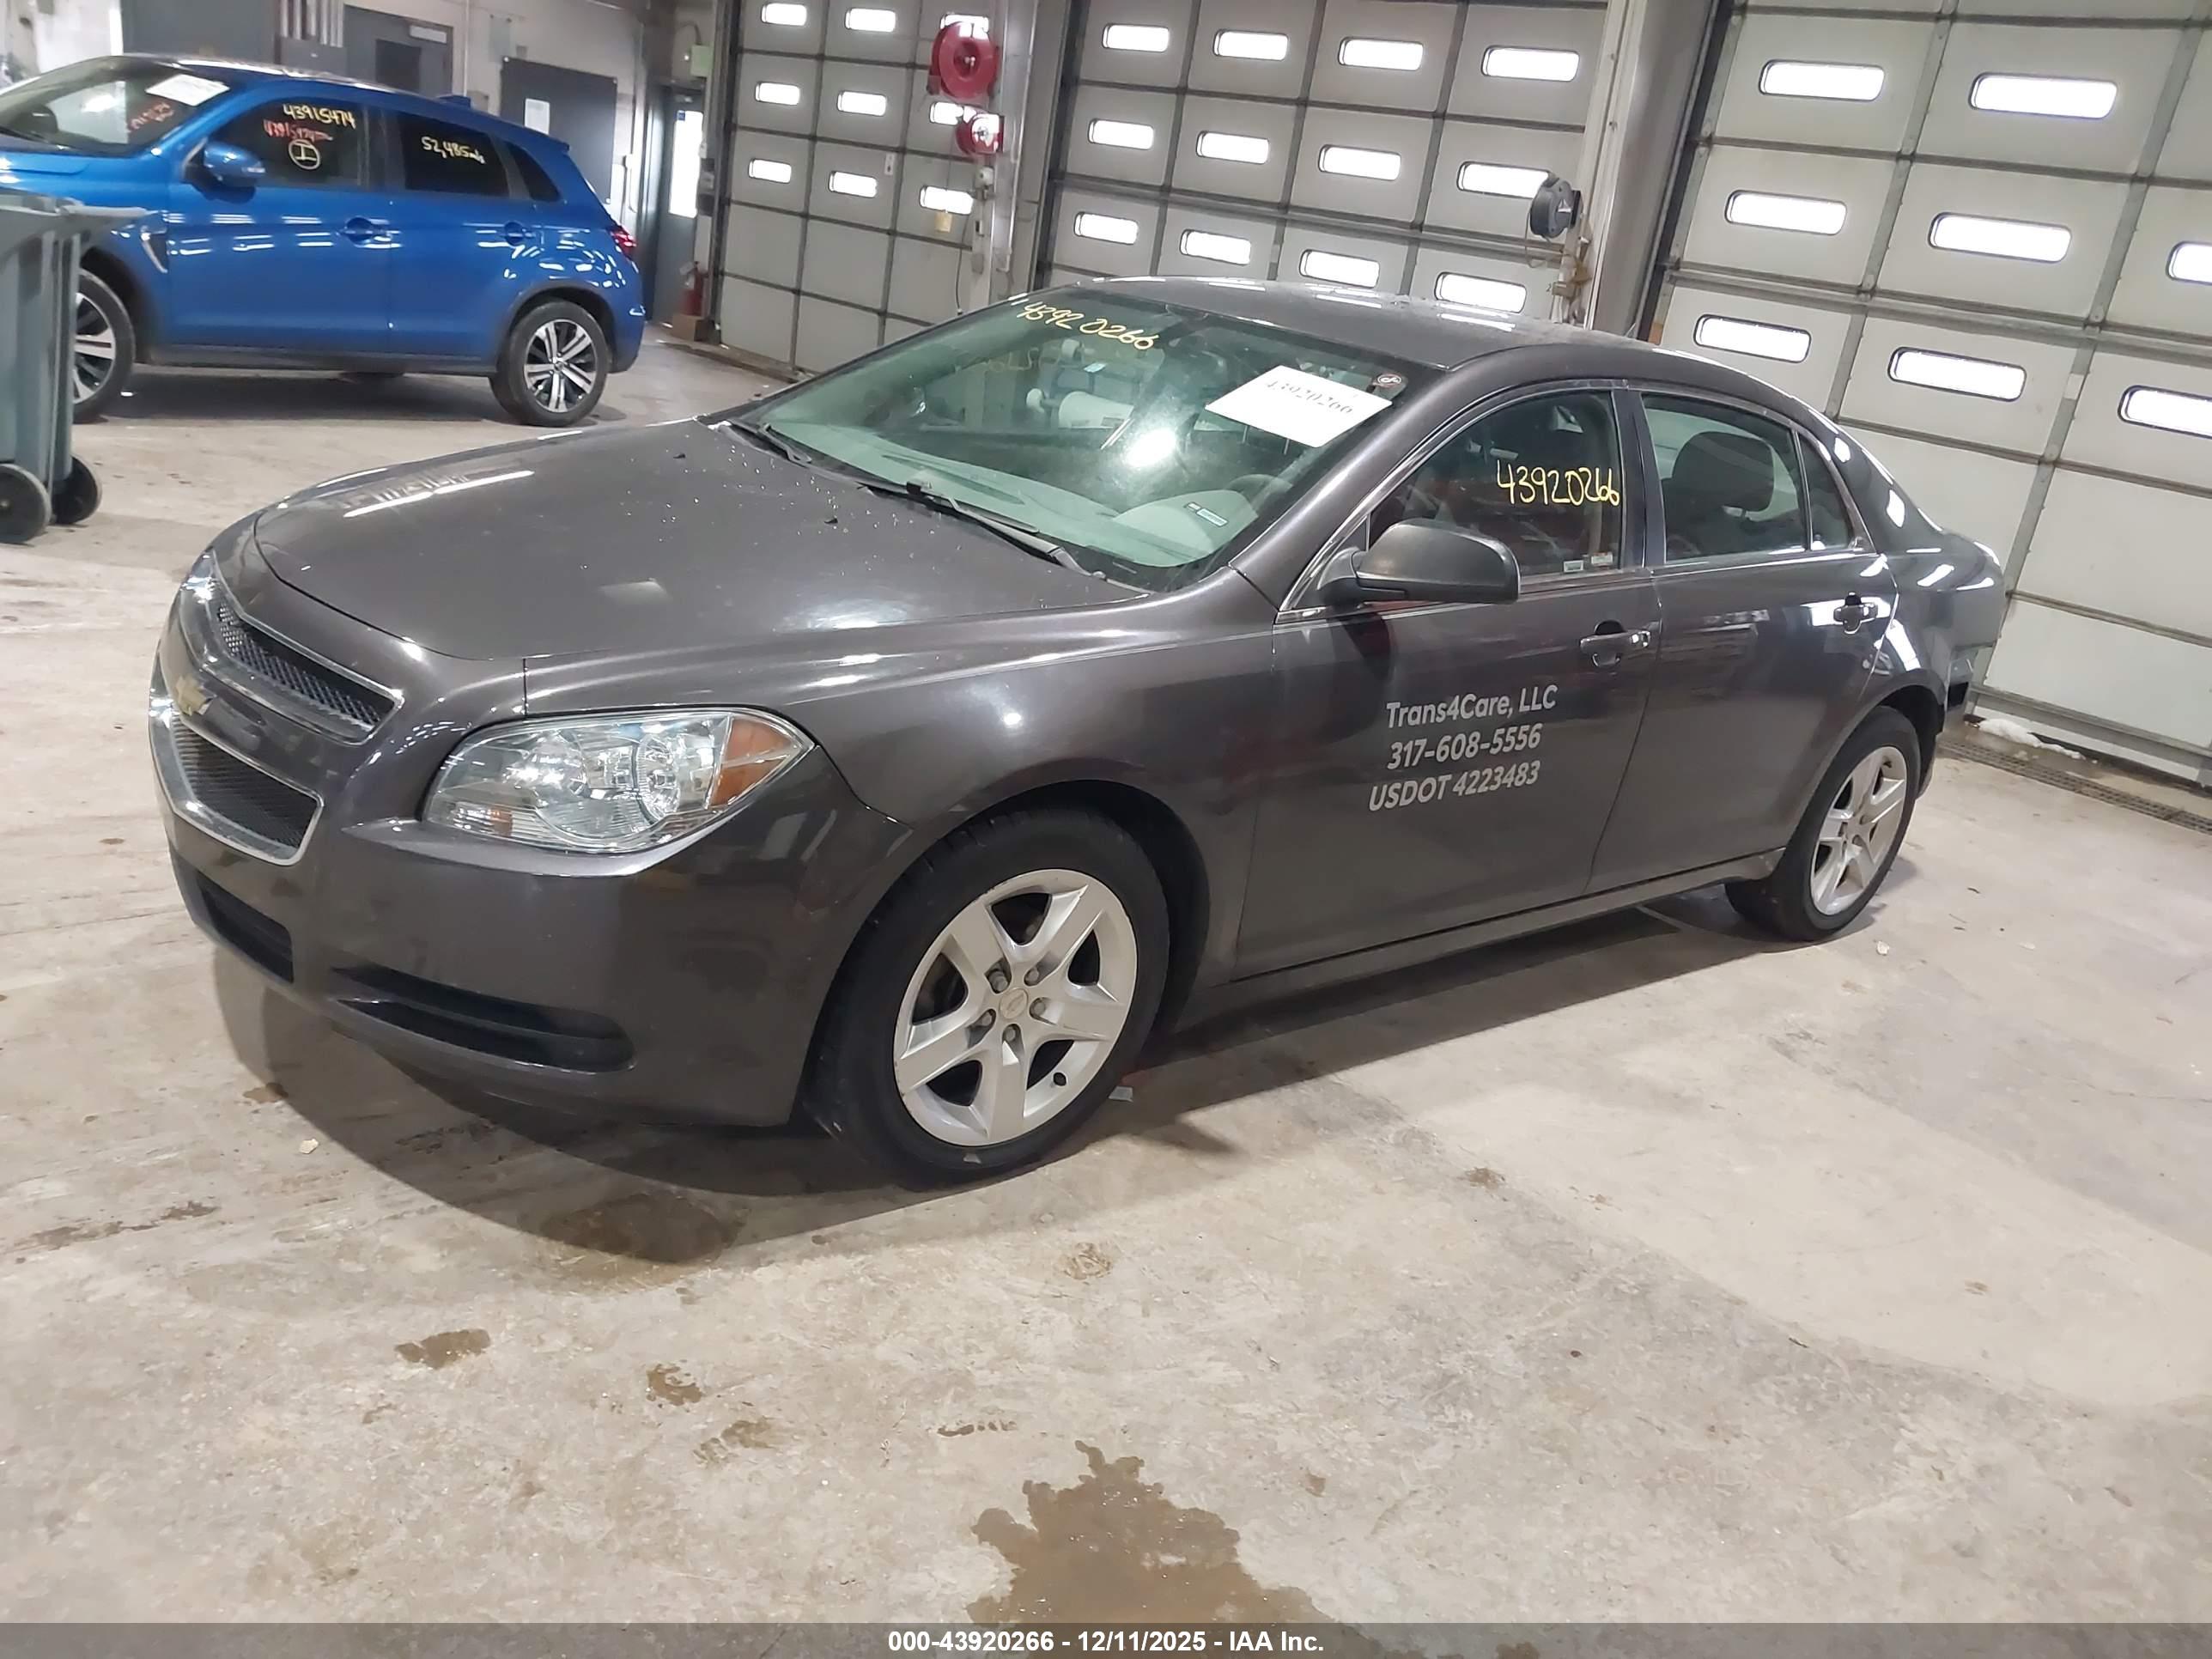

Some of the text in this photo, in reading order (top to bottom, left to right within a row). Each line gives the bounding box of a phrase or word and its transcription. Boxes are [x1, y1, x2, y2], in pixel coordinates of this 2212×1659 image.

[283, 104, 356, 129] 43915474
[1497, 459, 1620, 507] 43920266
[1386, 684, 1559, 729] Trans4Care, LLC
[1387, 722, 1543, 769] 317-608-5556
[1368, 760, 1541, 811] USDOT 4223483
